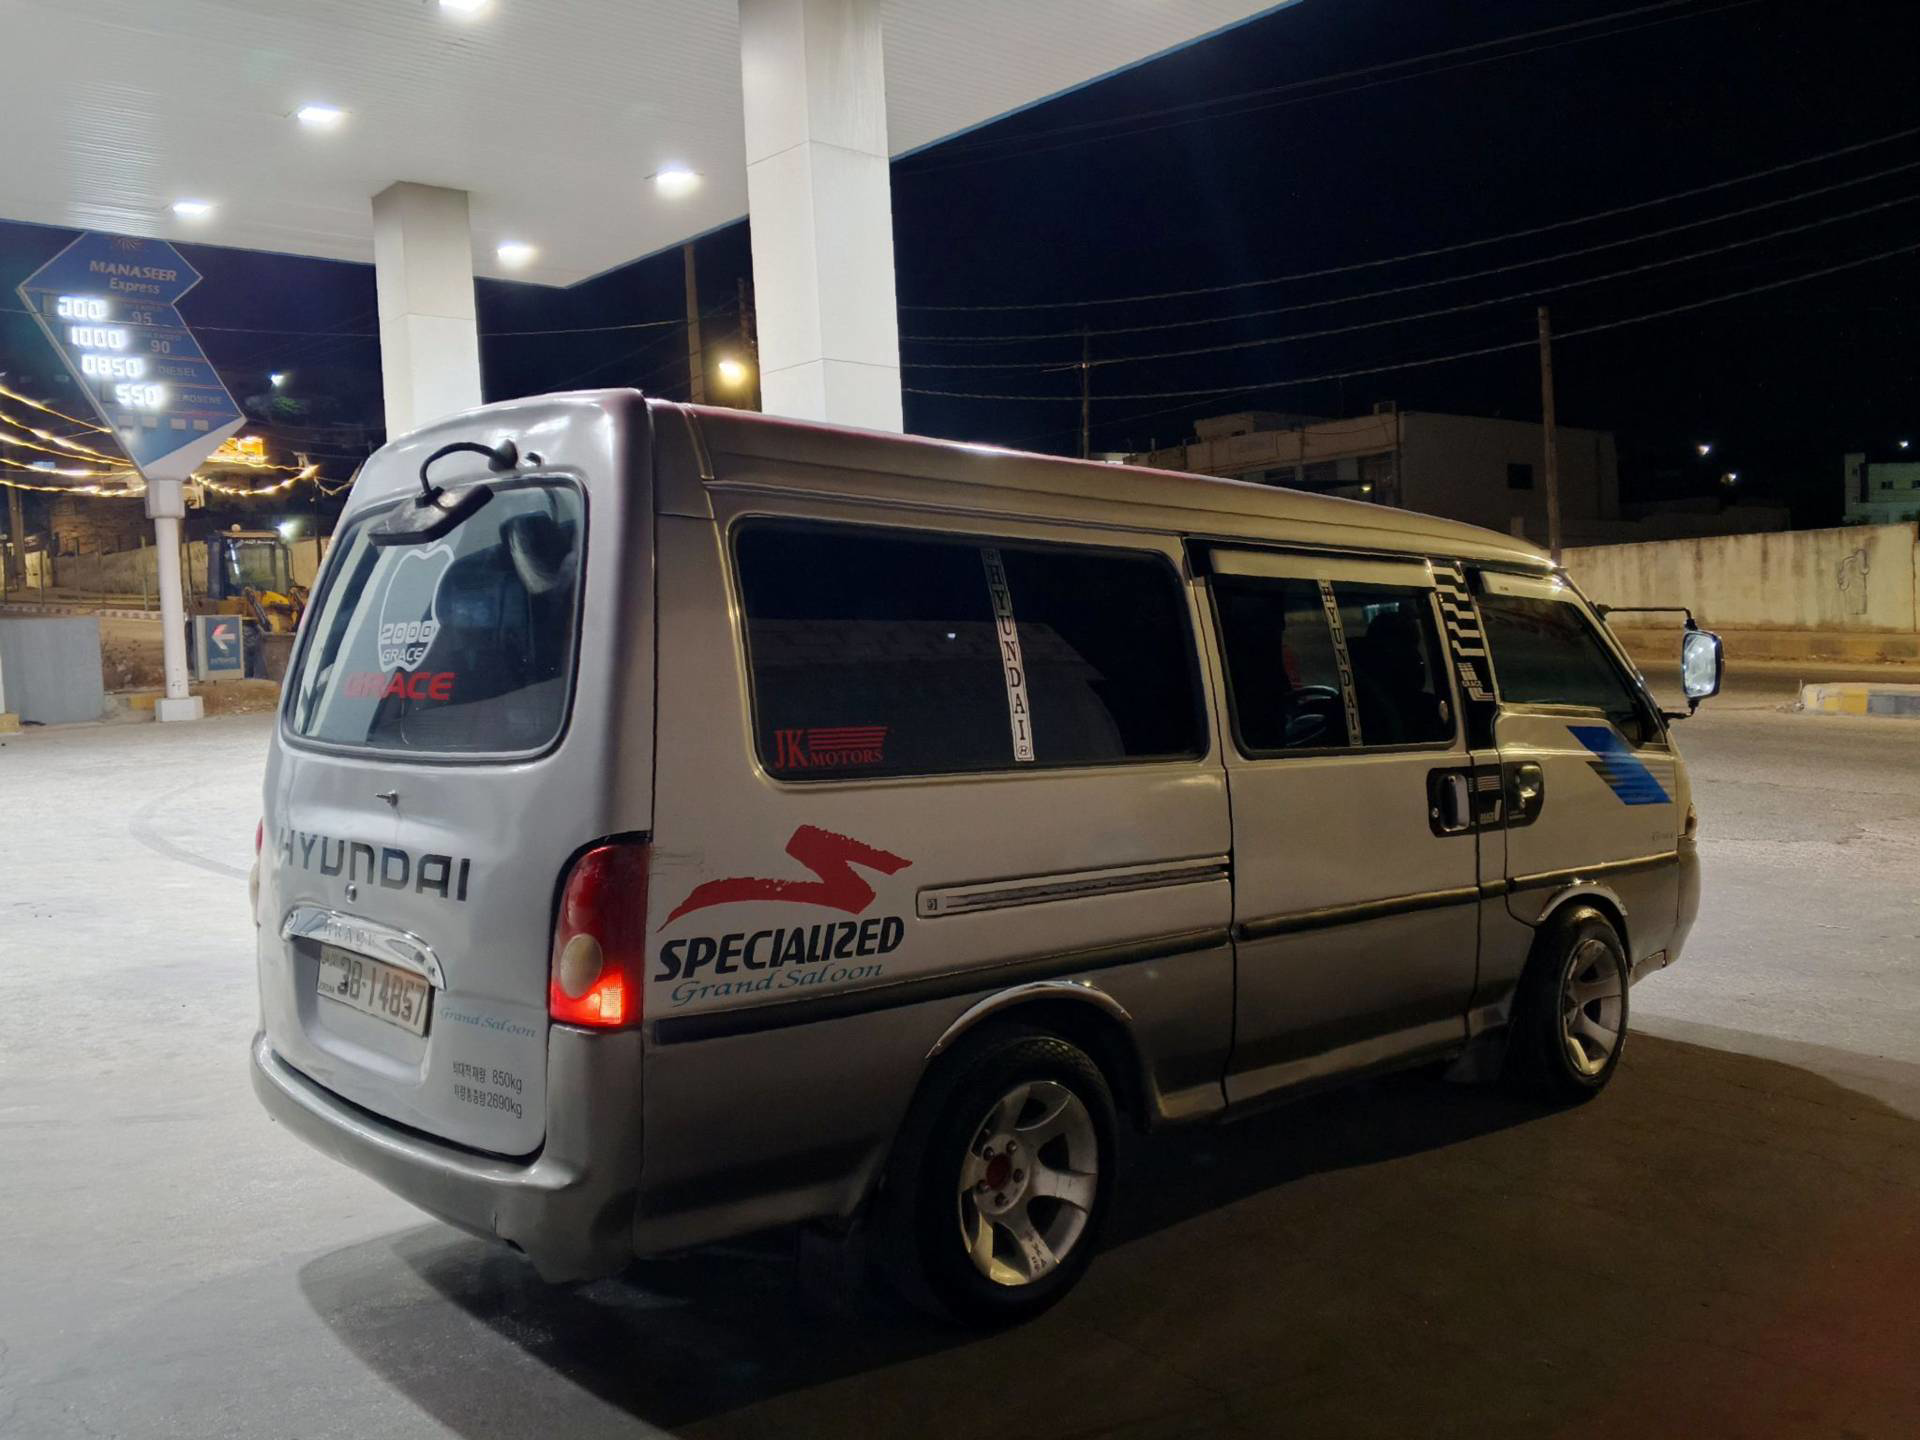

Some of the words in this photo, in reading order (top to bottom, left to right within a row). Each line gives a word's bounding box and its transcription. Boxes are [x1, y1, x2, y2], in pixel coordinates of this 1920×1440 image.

[90, 260, 177, 281] MANASEER
[110, 277, 160, 295] Express
[132, 311, 152, 325] 95
[151, 340, 170, 354] 90
[159, 366, 198, 377] DIESEL
[380, 620, 435, 645] 2000
[382, 647, 424, 662] GRACE
[990, 567, 1026, 741] HYUNDAI
[344, 671, 456, 700] GRACE
[773, 728, 808, 769] JK
[809, 750, 884, 767] MOTORS
[279, 827, 471, 901] HYUNDAI
[653, 915, 905, 983] SPECIALIZED
[671, 970, 783, 1008] Grand
[778, 962, 884, 989] Saloon
[440, 1007, 481, 1025] Grand
[481, 1016, 537, 1038] Saloon
[492, 1069, 522, 1095] 850kg
